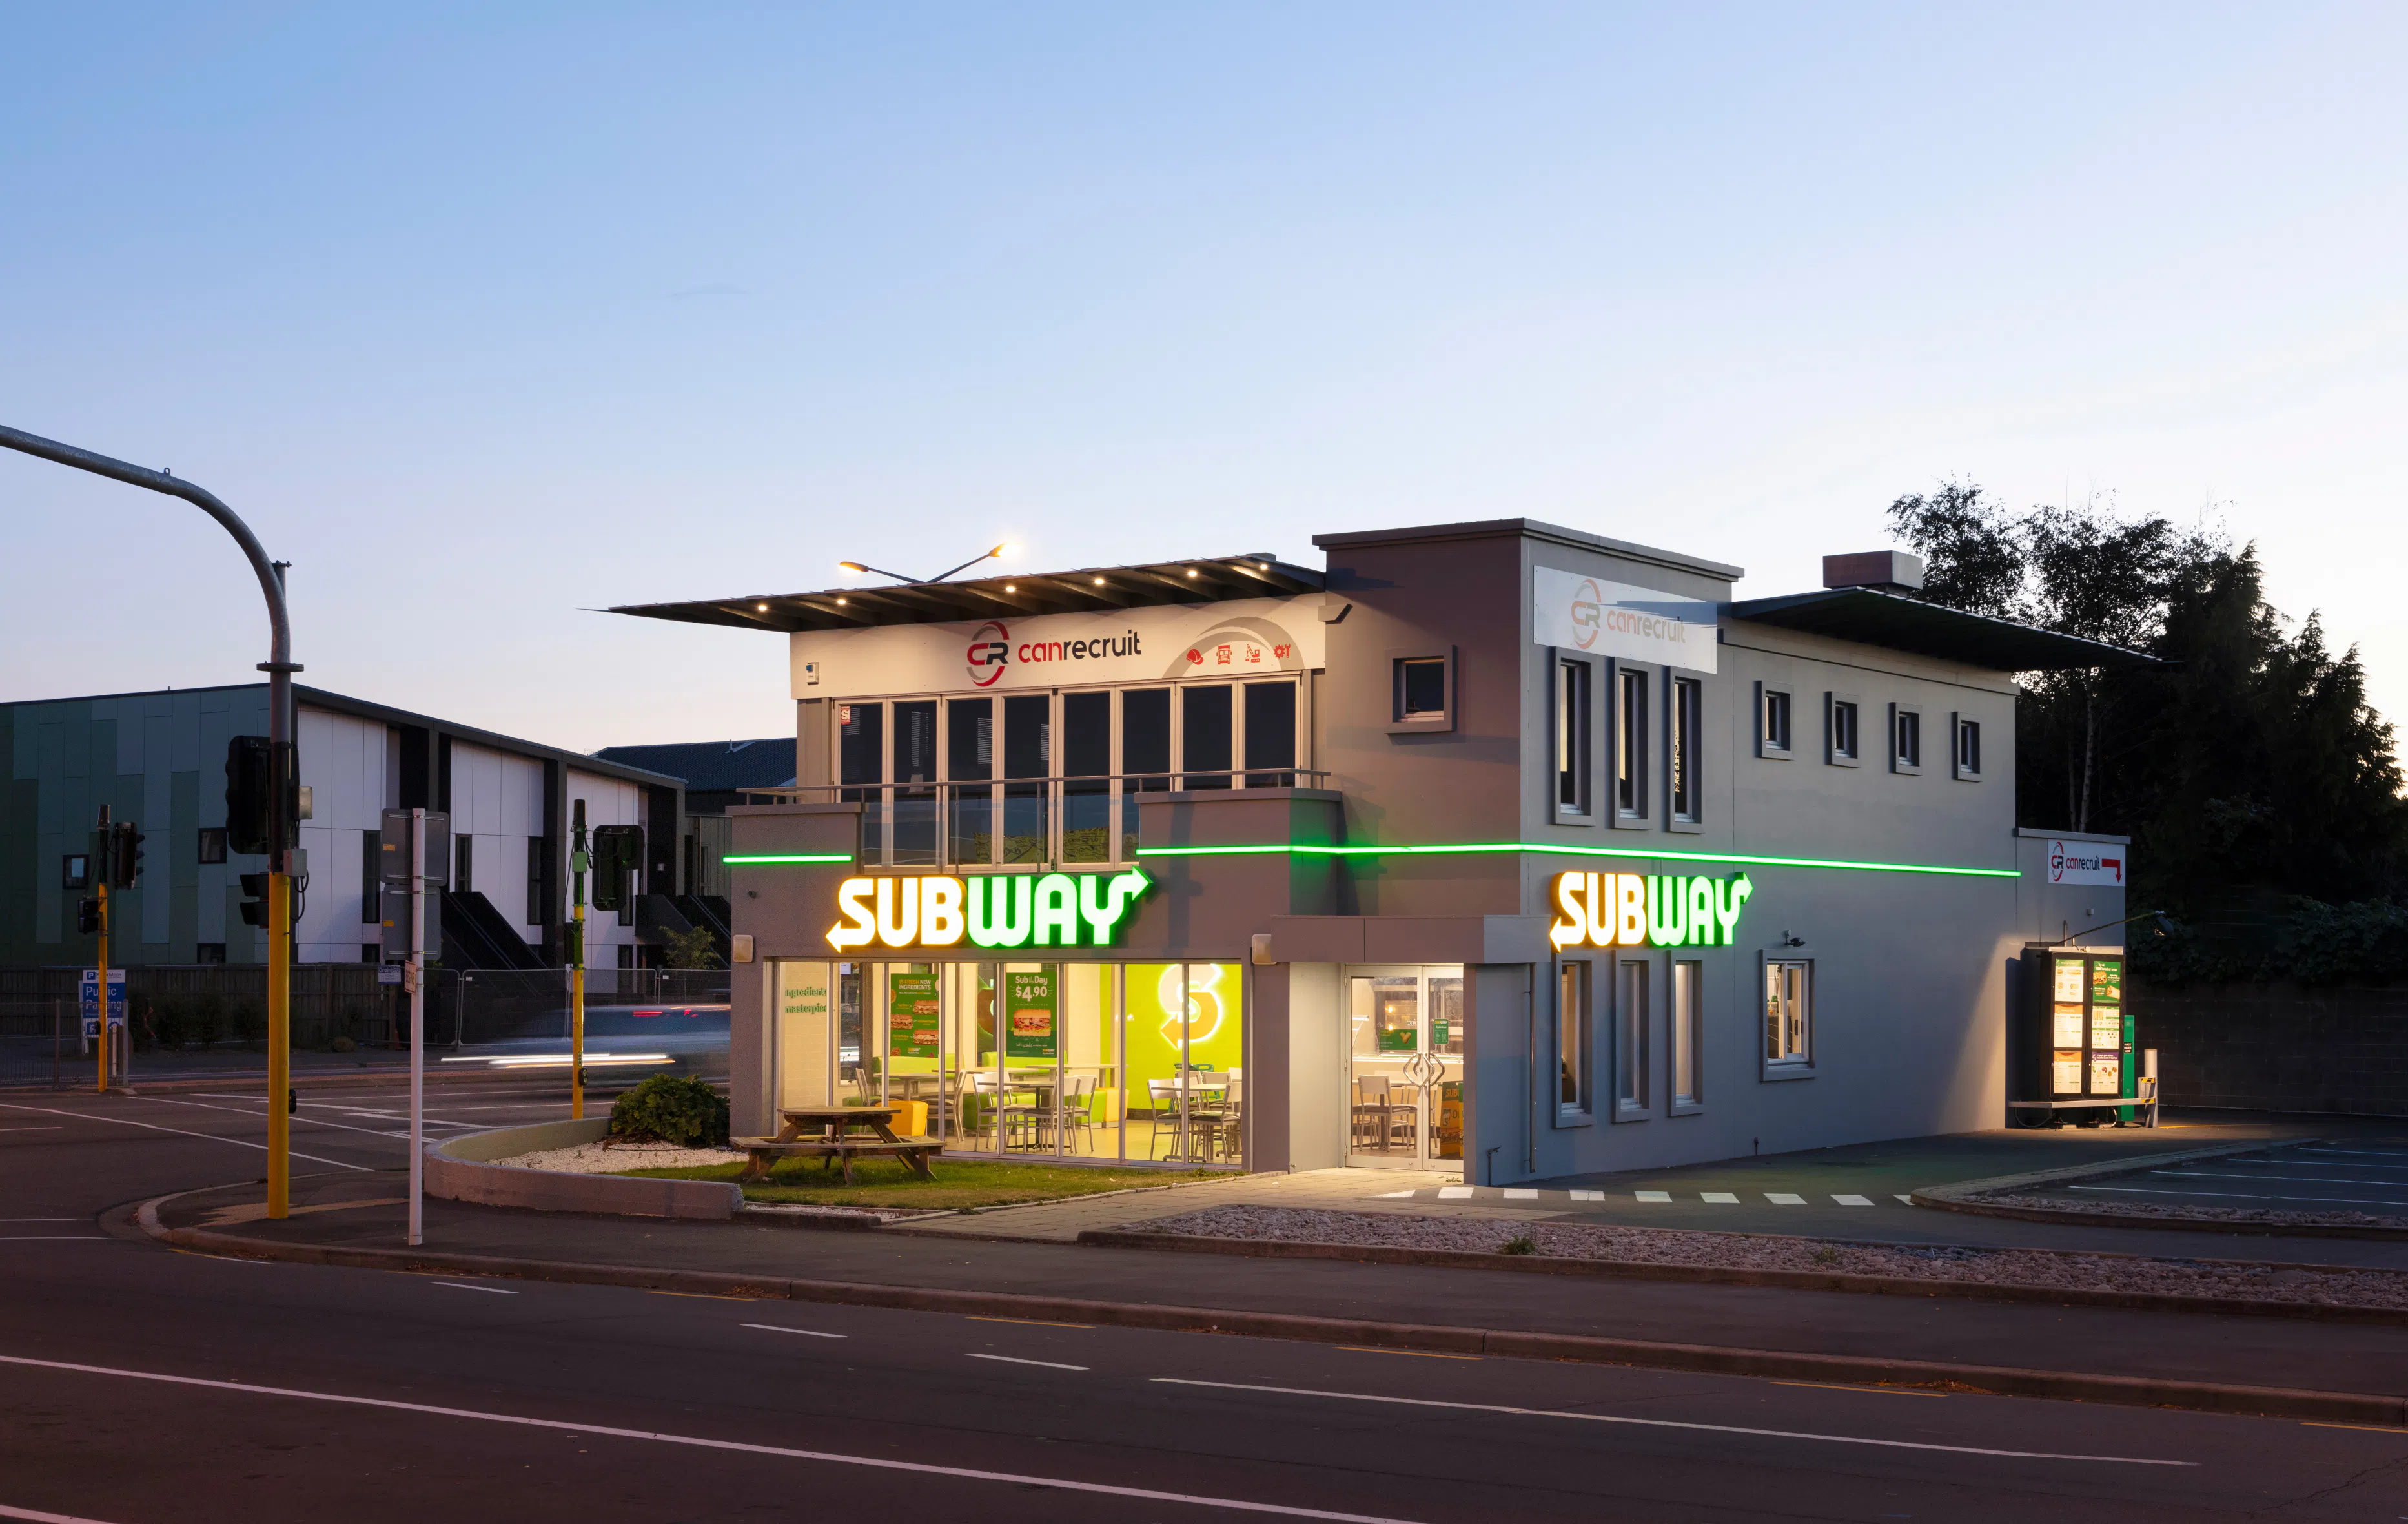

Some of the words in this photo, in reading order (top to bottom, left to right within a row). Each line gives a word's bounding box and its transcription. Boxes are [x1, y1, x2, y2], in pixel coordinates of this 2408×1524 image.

[1571, 601, 1601, 629] CR
[1607, 610, 1686, 644] canrecruit
[967, 642, 1009, 666] CR
[1018, 629, 1142, 663] canrecruit
[2051, 855, 2064, 869] CR
[2066, 855, 2100, 870] canrecruit
[826, 865, 1154, 953] SUBWAY
[1549, 871, 1753, 953] SUBWAY
[1015, 975, 1028, 983] Sub
[1034, 976, 1048, 985] Day
[86, 986, 116, 996] Puic
[1015, 985, 1048, 1002] $4.90
[86, 999, 121, 1011] Paing
